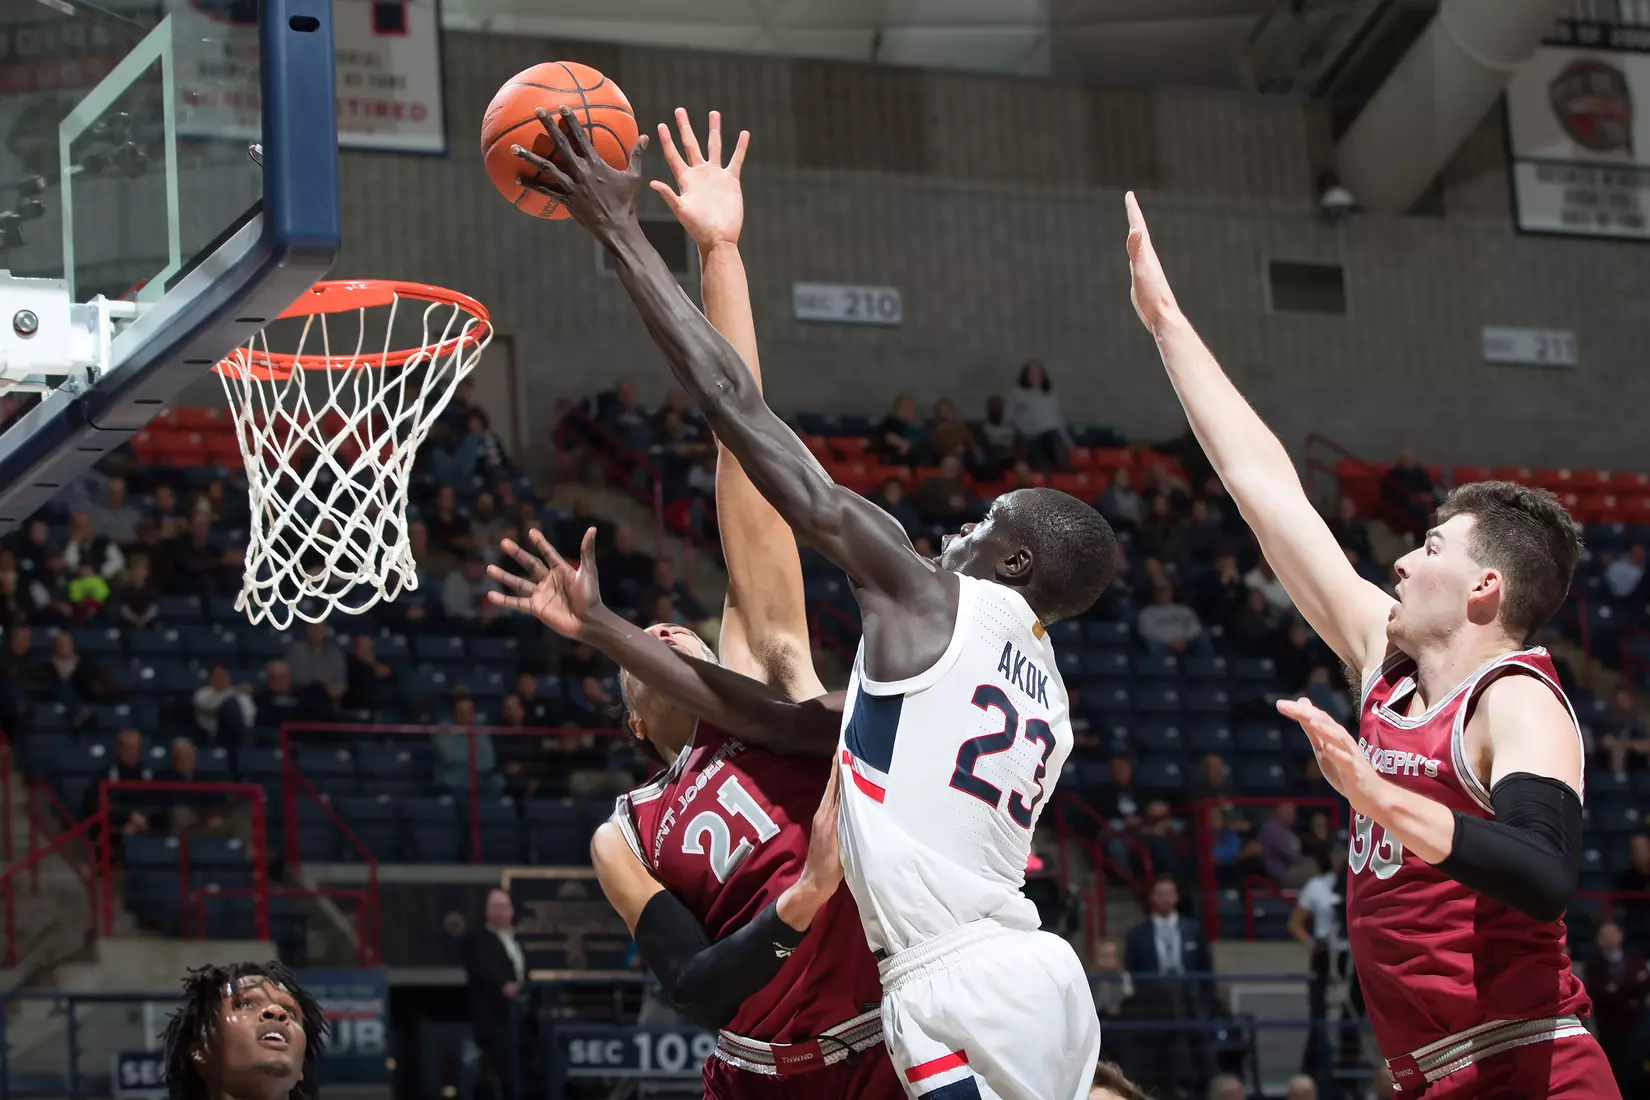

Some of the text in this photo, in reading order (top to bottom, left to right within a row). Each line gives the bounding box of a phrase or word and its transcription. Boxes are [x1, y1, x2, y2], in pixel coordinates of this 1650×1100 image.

[841, 289, 901, 319] 210
[997, 640, 1050, 710] AKOK
[949, 684, 1057, 829] 23
[682, 775, 781, 885] 21
[321, 1019, 387, 1054] UB
[568, 1032, 716, 1073] SEC 109
[781, 1052, 814, 1065] THWND
